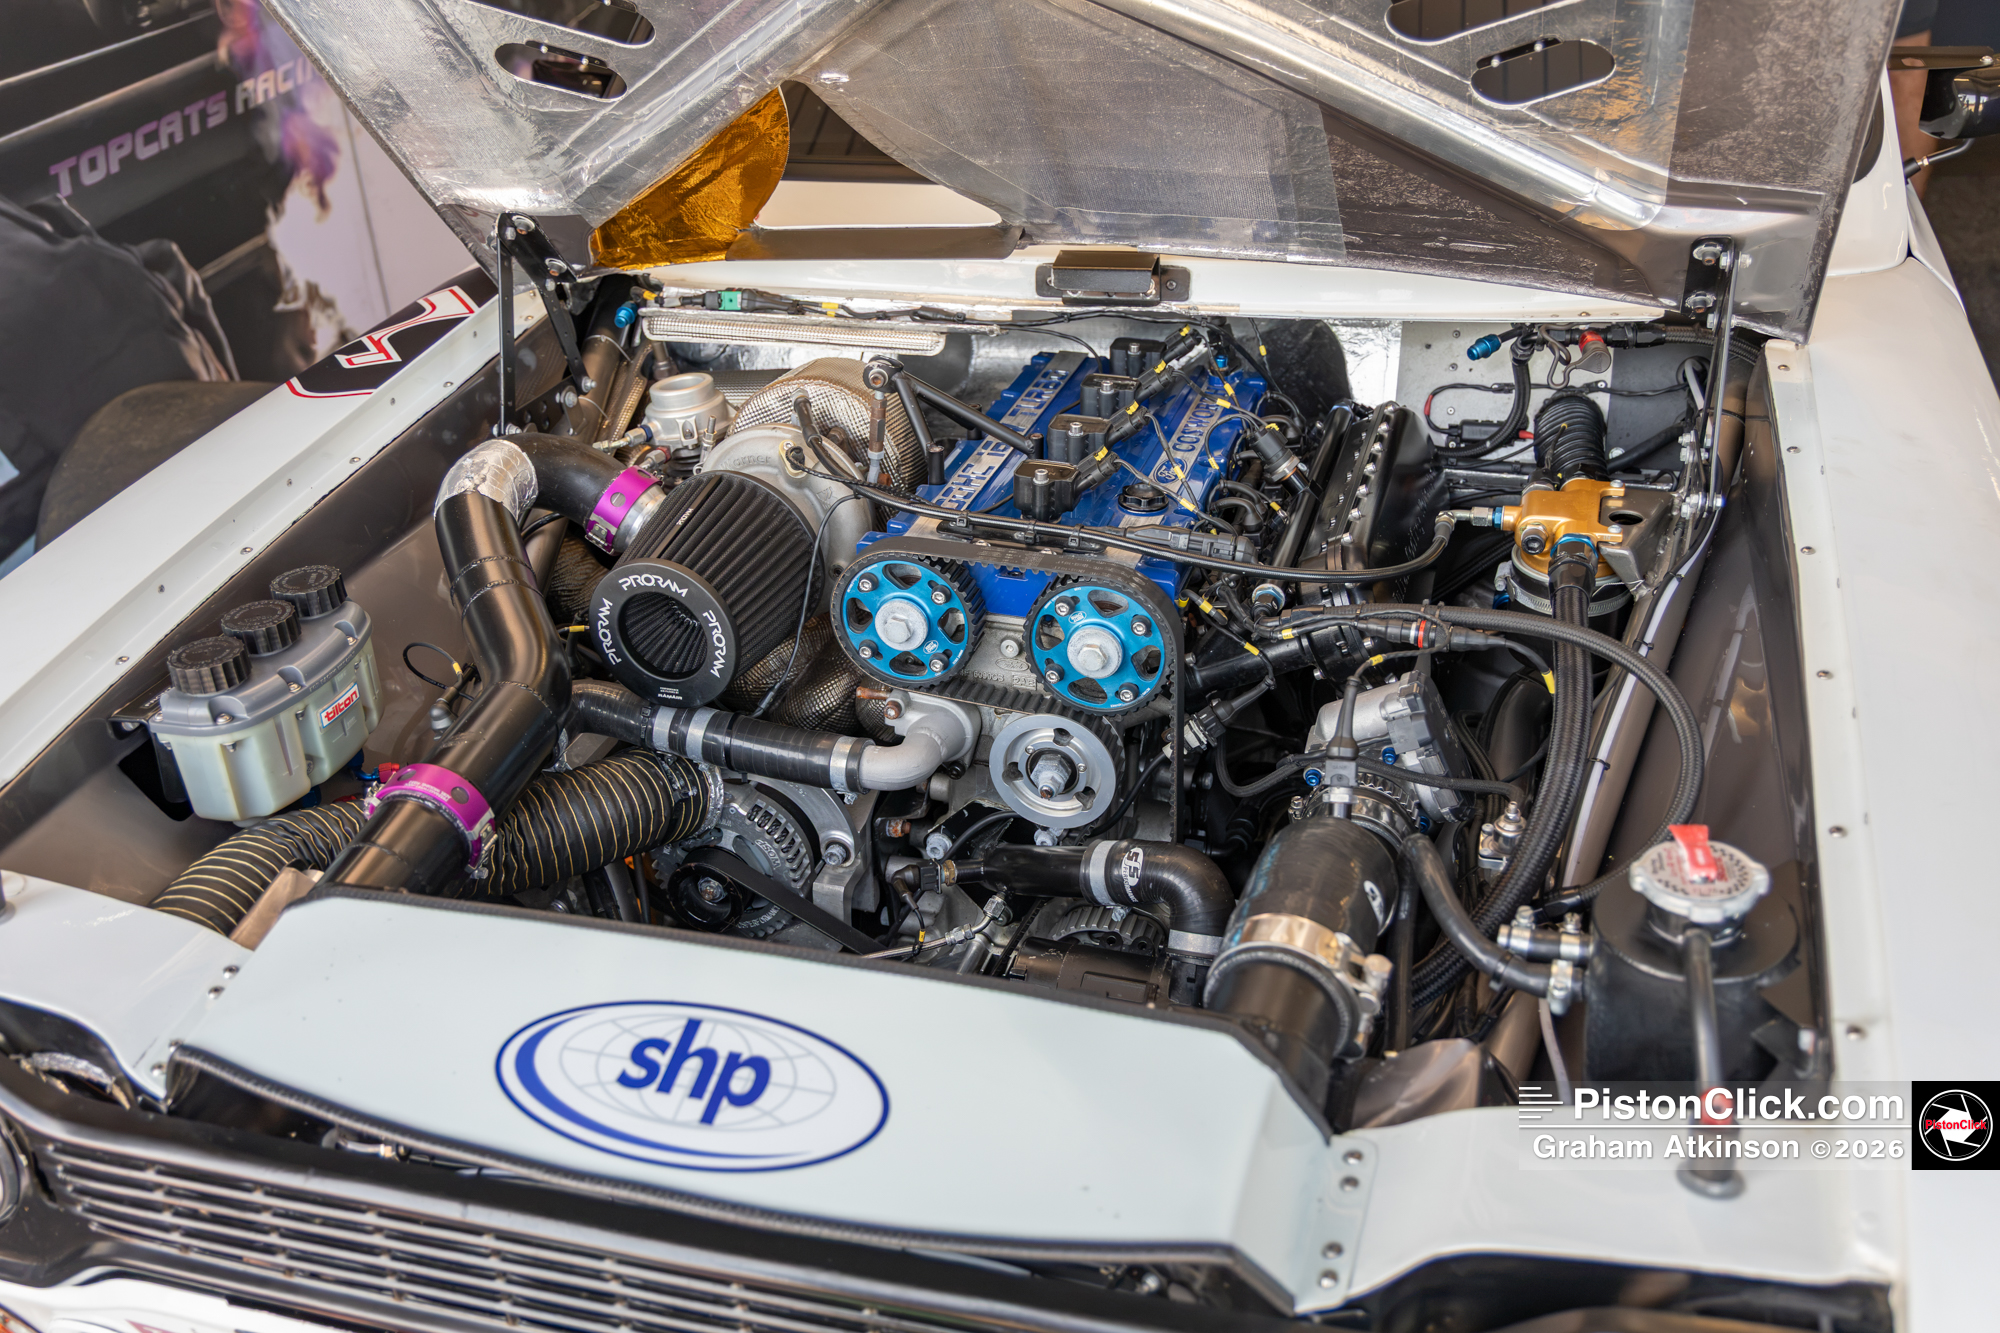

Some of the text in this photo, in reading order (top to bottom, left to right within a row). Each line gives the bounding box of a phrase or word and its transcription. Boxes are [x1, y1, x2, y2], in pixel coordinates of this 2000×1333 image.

[50, 90, 228, 197] TOPCATS
[1007, 369, 1070, 417] TURBO
[1172, 385, 1228, 453] COSWORH
[618, 573, 689, 598] PRORAM
[324, 689, 358, 722] tilton
[755, 839, 781, 870] WOSP
[616, 1017, 771, 1126] shp
